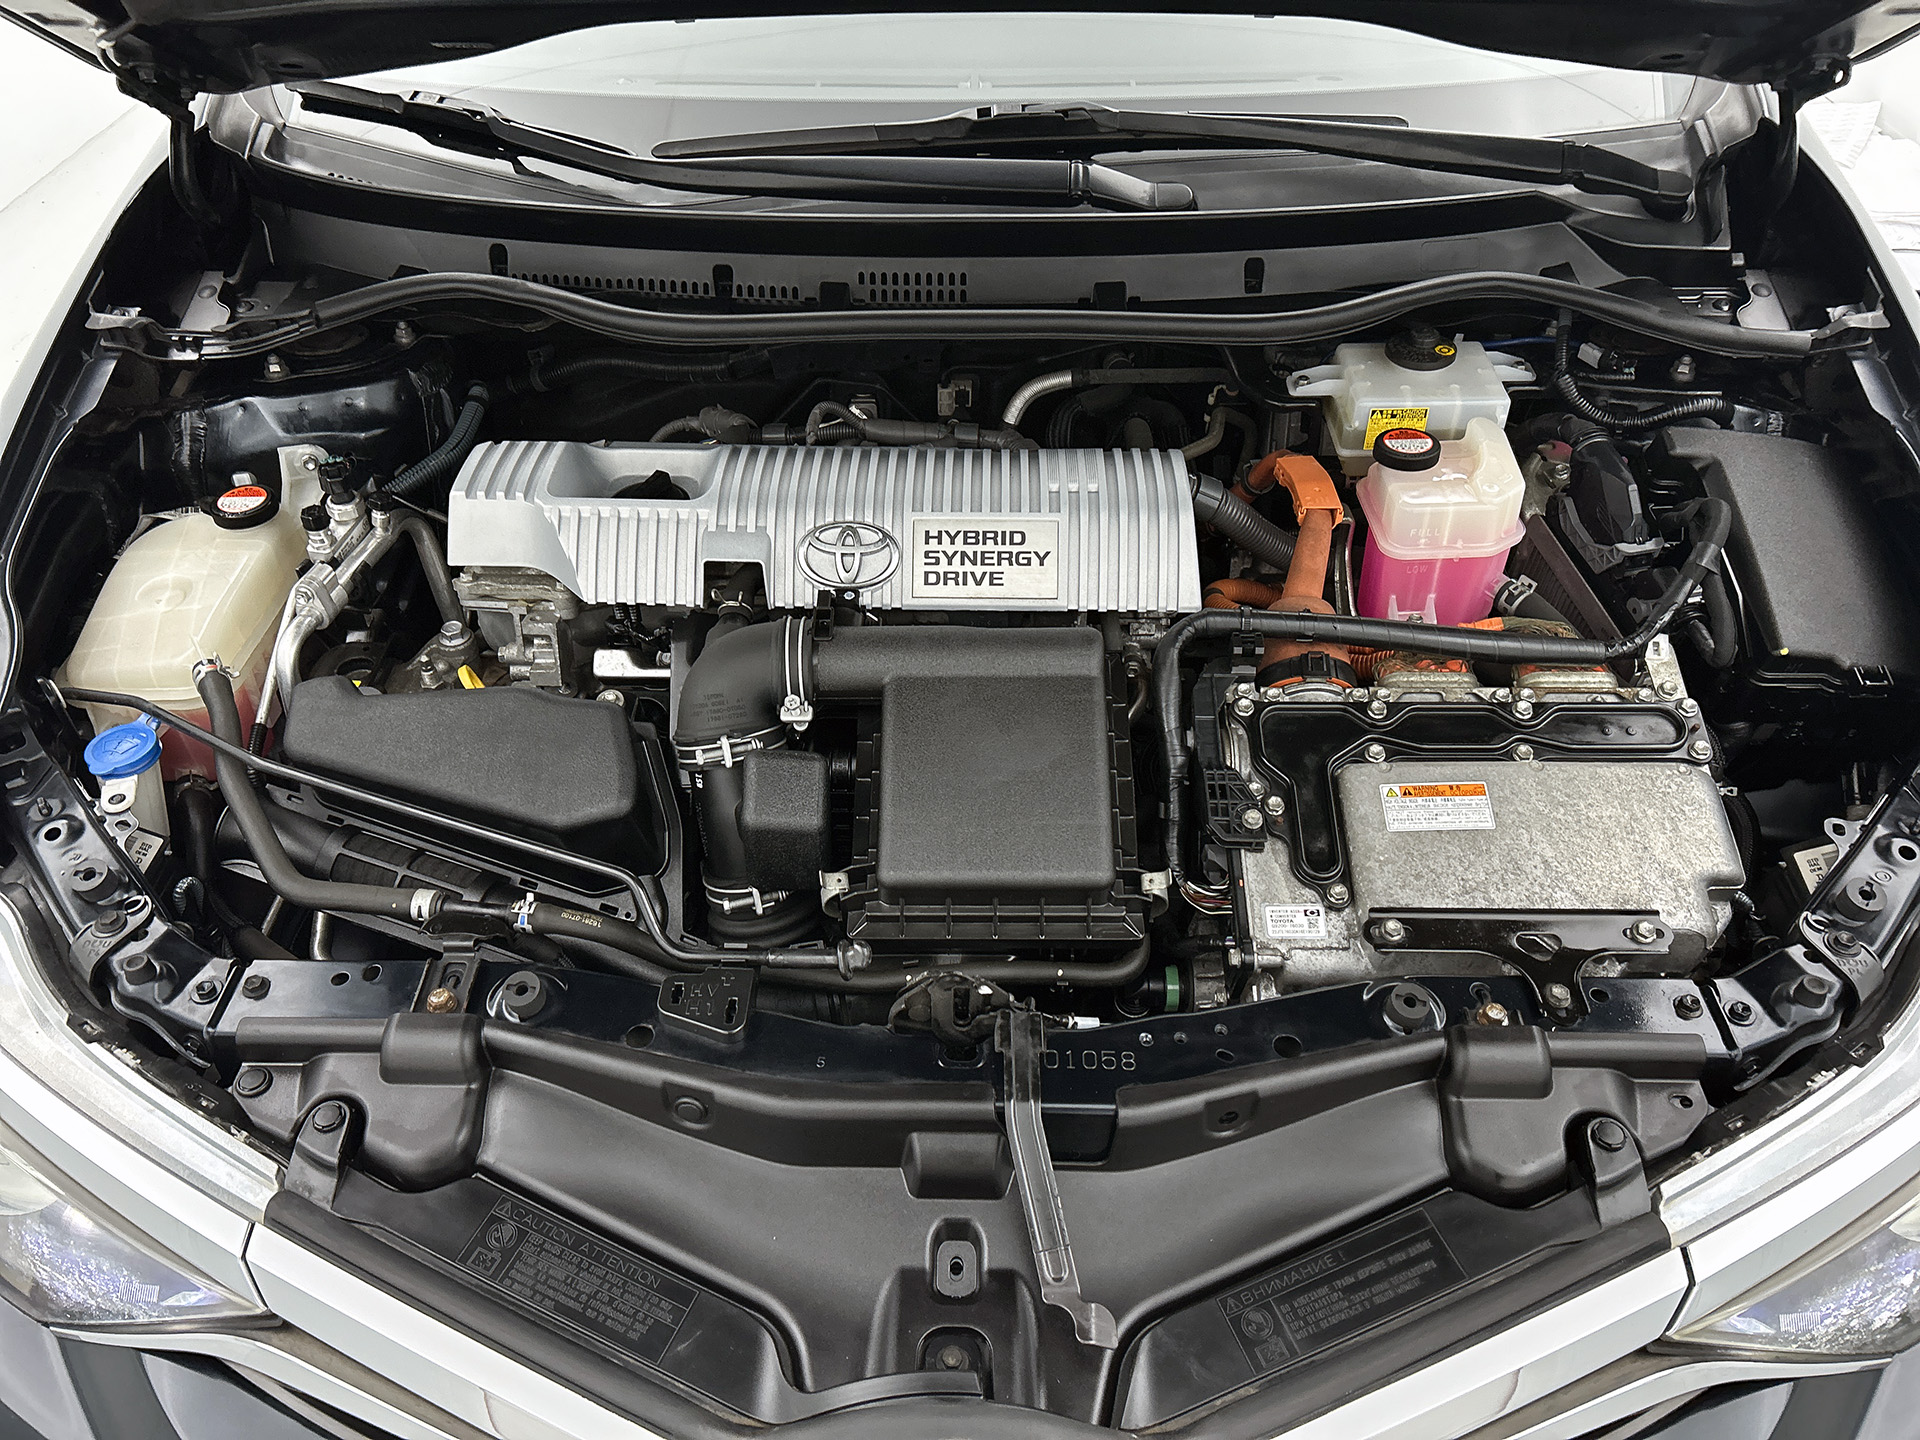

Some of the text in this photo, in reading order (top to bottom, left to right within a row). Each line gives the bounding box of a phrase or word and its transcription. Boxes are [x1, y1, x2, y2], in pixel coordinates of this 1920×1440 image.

[924, 530, 1026, 546] HYBRID
[1410, 528, 1440, 538] FULL
[923, 550, 1051, 566] SYNERGY
[1406, 565, 1428, 574] LOW
[923, 571, 1004, 586] DRIVE
[816, 1056, 826, 1068] 5
[1044, 1050, 1136, 1071] 01058
[510, 1207, 662, 1289] CAUTION ATTENTION
[1239, 1253, 1338, 1305] ВНИМАНИЕ
